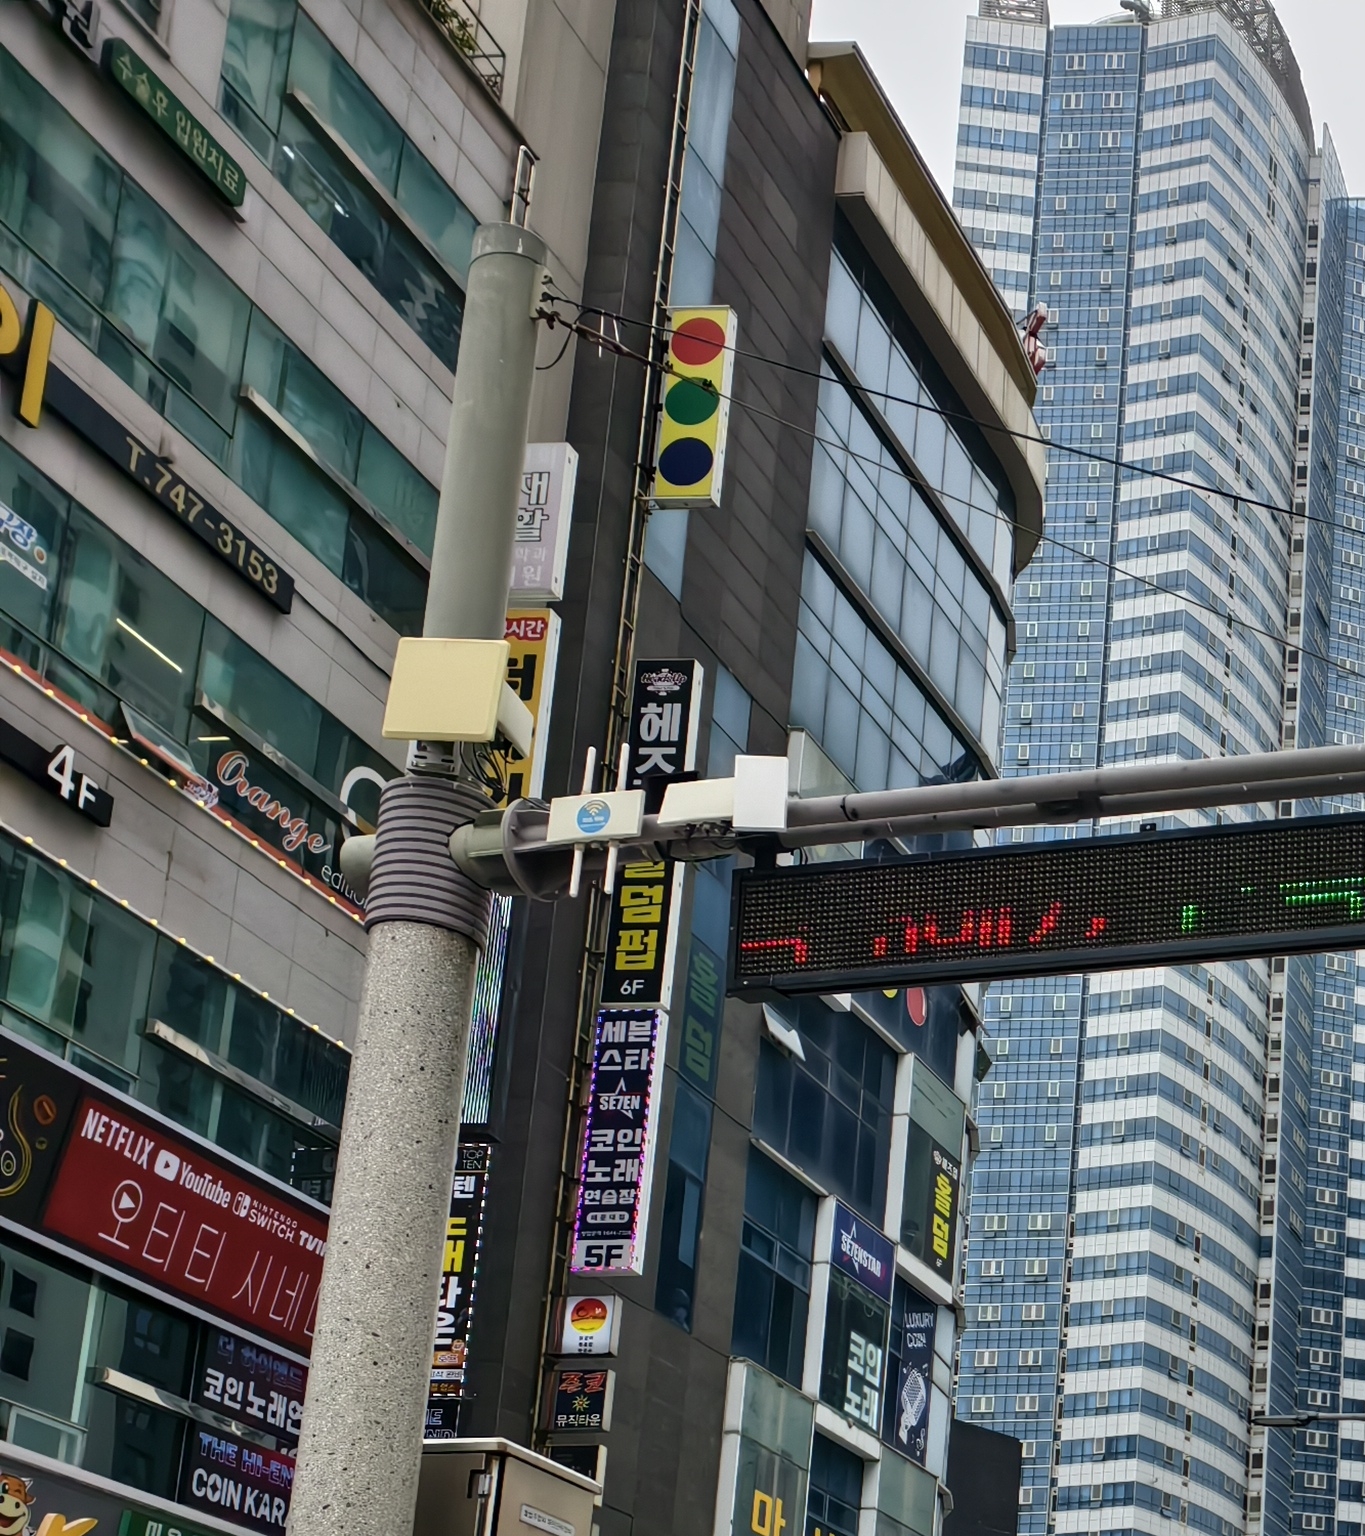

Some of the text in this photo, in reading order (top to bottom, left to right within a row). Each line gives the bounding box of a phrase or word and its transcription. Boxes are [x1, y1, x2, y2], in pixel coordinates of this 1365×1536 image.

[125, 435, 281, 592] T.747-3153
[46, 745, 97, 809] 4F
[217, 750, 332, 854] Orange
[620, 978, 645, 995] 6F
[600, 1019, 653, 1046] 세븐
[597, 1047, 650, 1073] 스타
[589, 1127, 642, 1153] 코인
[81, 1108, 232, 1208] NETFLIX YouTube
[462, 1149, 484, 1159] TOP
[462, 1160, 483, 1170] TEN
[586, 1157, 640, 1184] 노래
[582, 1189, 637, 1206] 연습장
[252, 1200, 299, 1229] NINTENDO
[248, 1213, 296, 1244] SWITCH
[583, 1244, 627, 1268] 5F
[556, 1413, 601, 1427] 뮤직타운
[199, 1431, 238, 1467] THE
[192, 1467, 243, 1512] COIN
